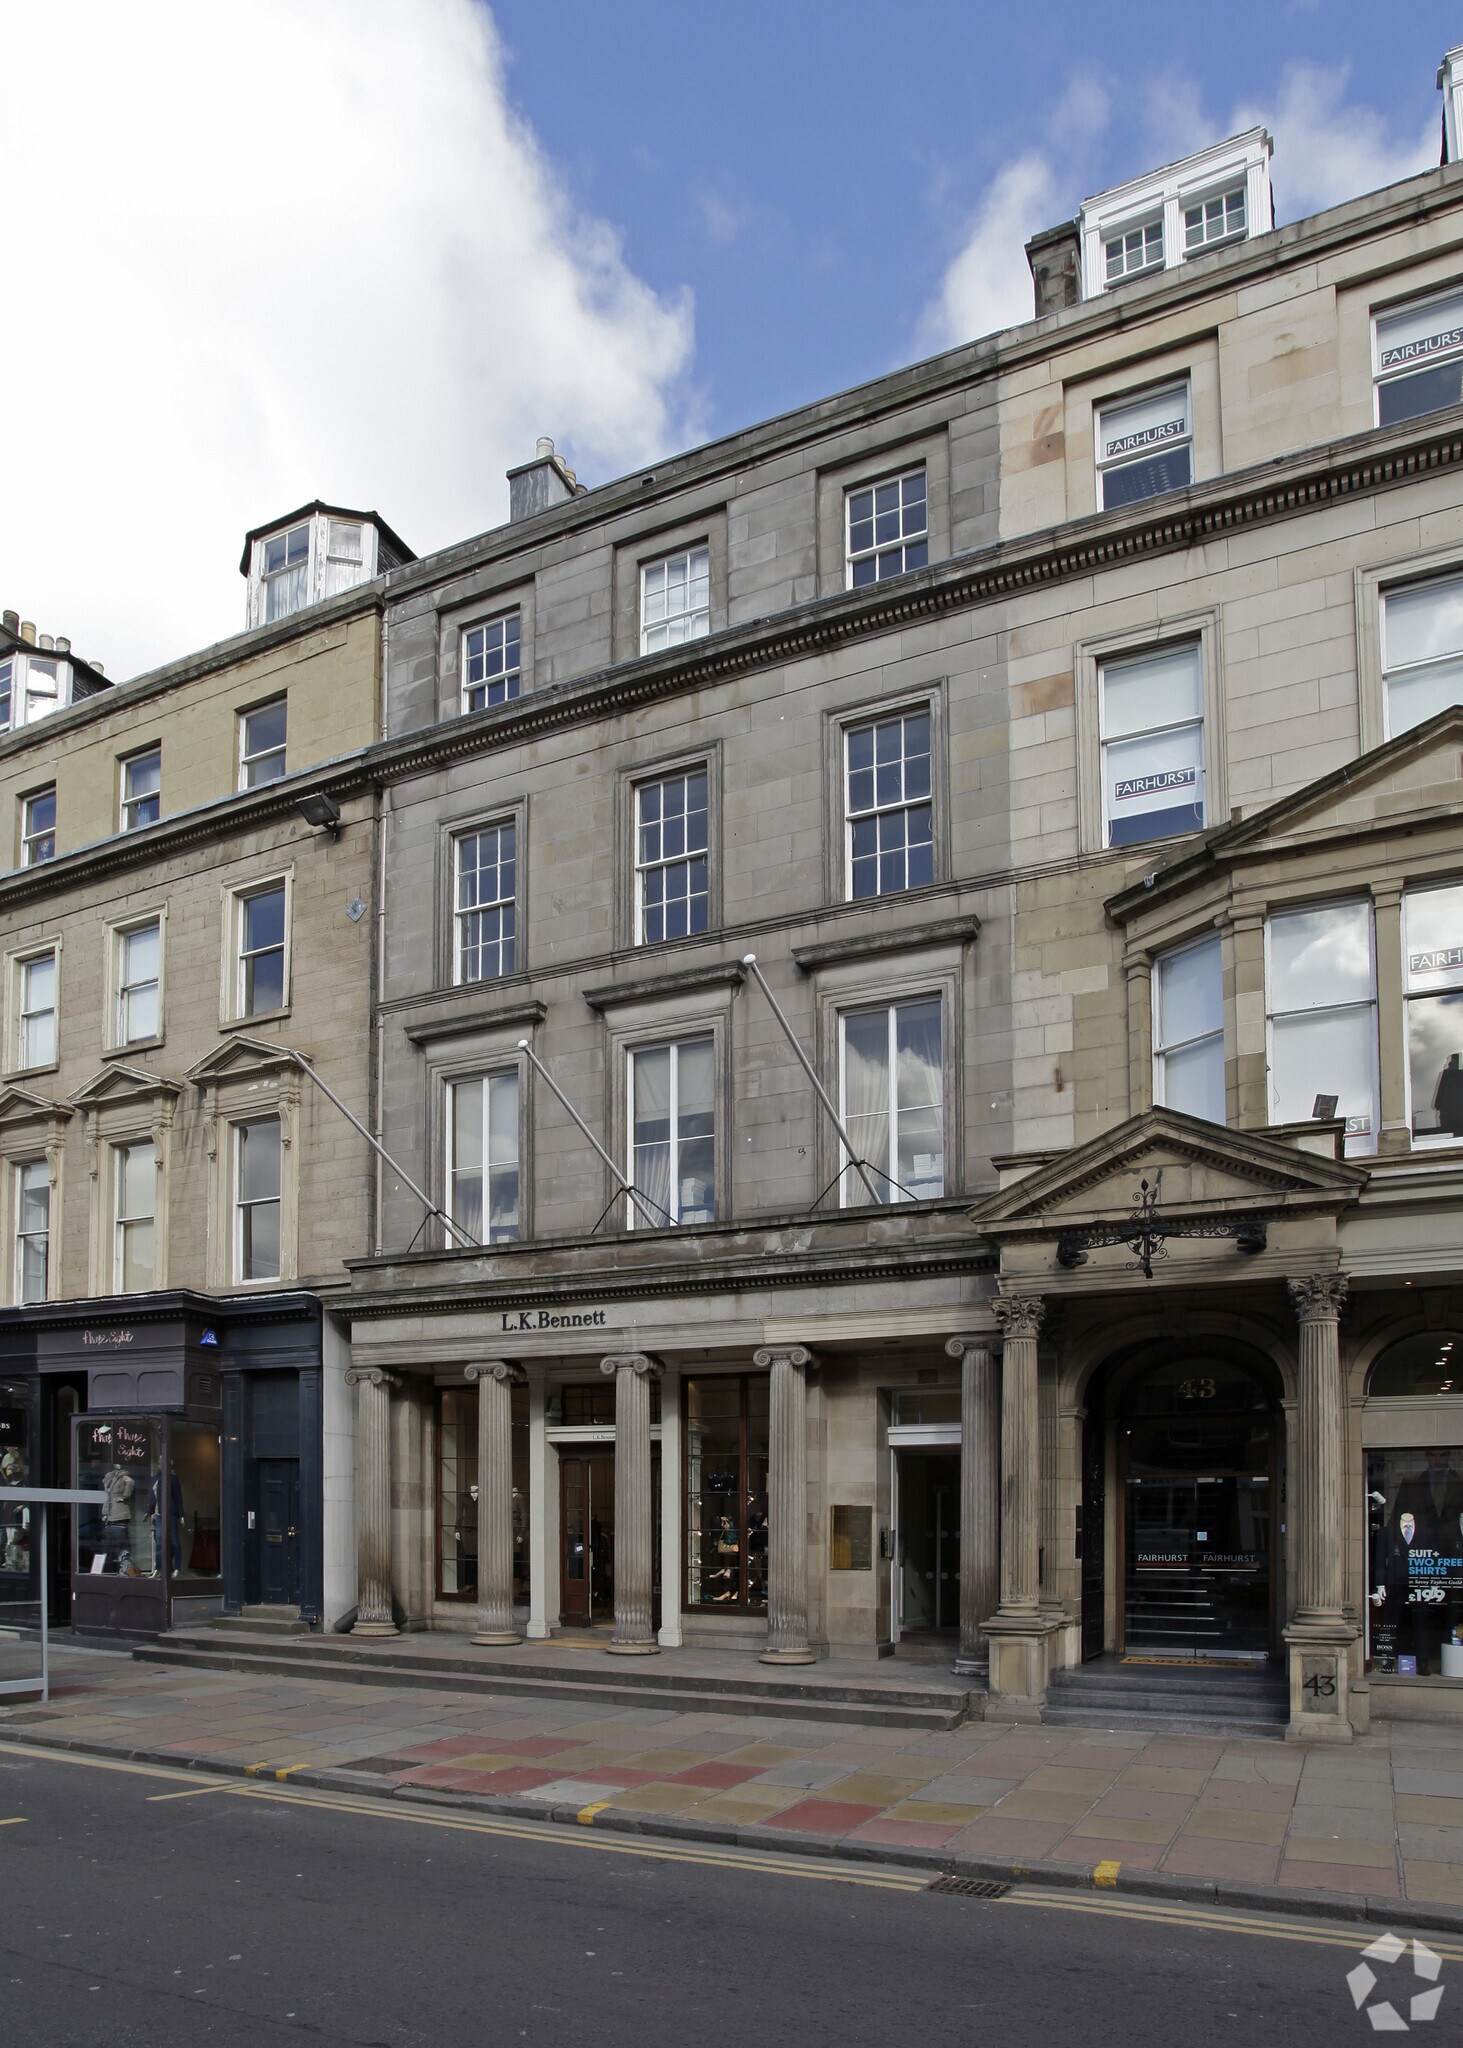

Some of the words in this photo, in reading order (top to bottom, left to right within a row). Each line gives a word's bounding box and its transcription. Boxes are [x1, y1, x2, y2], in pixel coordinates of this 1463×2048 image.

[1382, 329, 1463, 365] FAIRHURS
[1107, 420, 1183, 455] FAIRHURST
[1116, 769, 1194, 796] FAIRHURST
[1411, 949, 1463, 970] FAIRH
[501, 1310, 607, 1331] L.K.Bennett
[1177, 1378, 1216, 1398] 43
[1138, 1554, 1188, 1562] FAIRHURST
[1203, 1554, 1256, 1563] FAIRHURST
[1408, 1558, 1434, 1567] TWO
[1437, 1558, 1463, 1567] FREE
[1409, 1549, 1440, 1558] SUIT+
[1408, 1566, 1447, 1575] SHIRTS
[1302, 1673, 1335, 1697] 43
